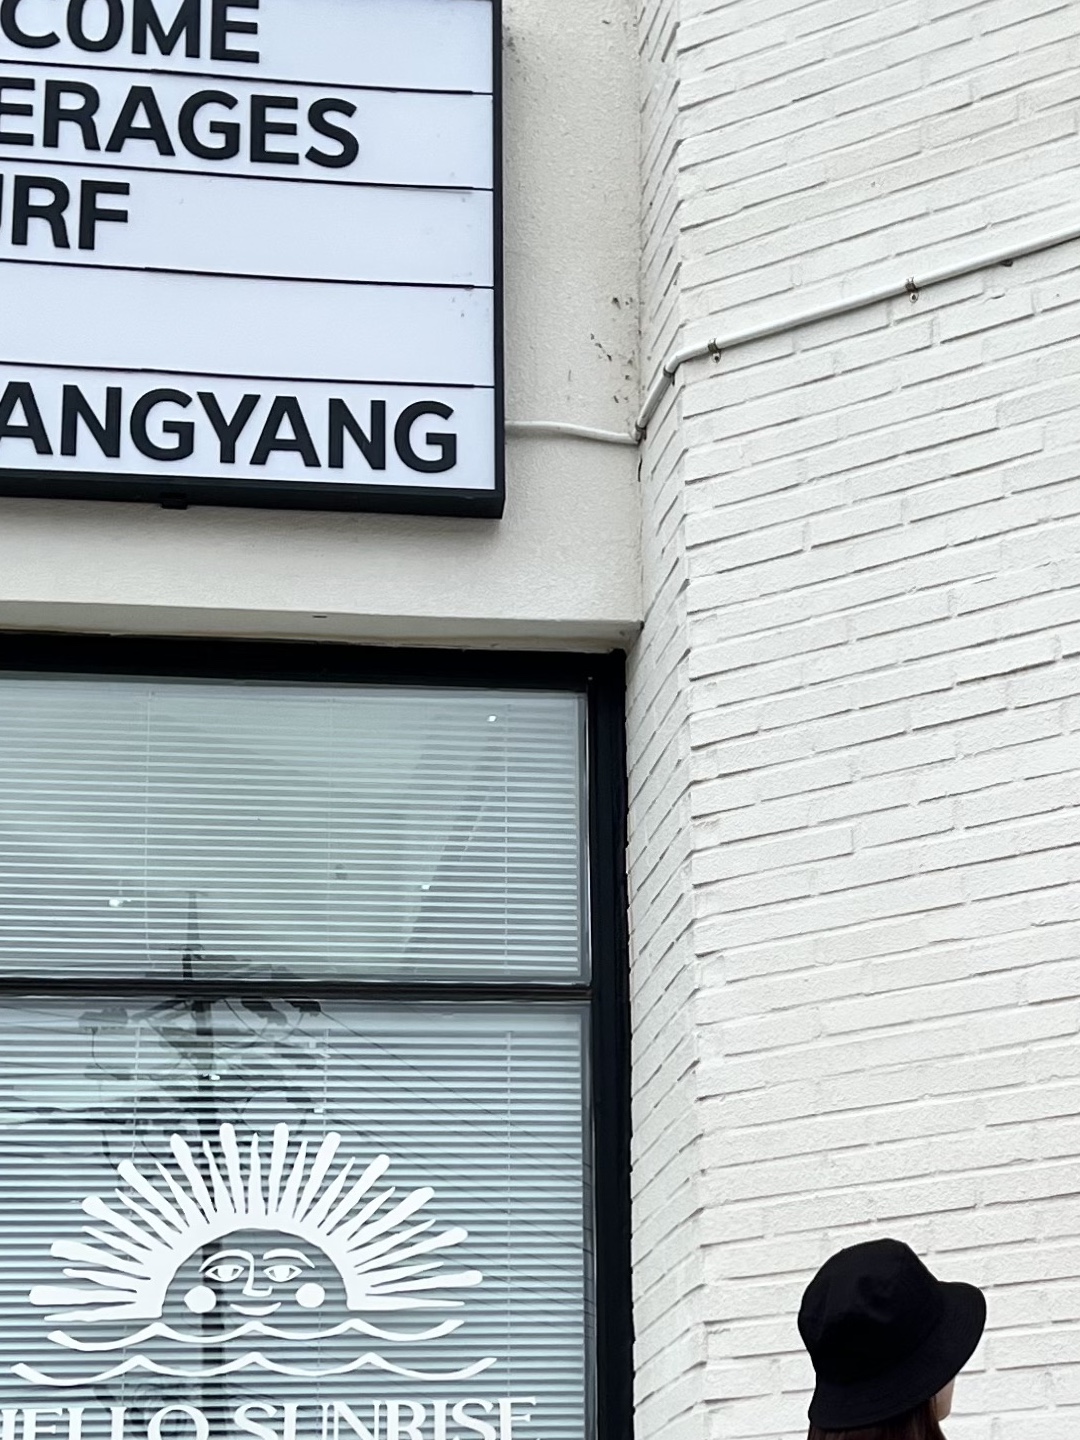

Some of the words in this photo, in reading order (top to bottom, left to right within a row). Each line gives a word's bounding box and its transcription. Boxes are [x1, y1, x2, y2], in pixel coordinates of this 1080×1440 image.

[0, 0, 260, 63] COME
[0, 77, 359, 168] ERAGES
[0, 172, 130, 250] RF
[0, 381, 457, 473] ANGYANG
